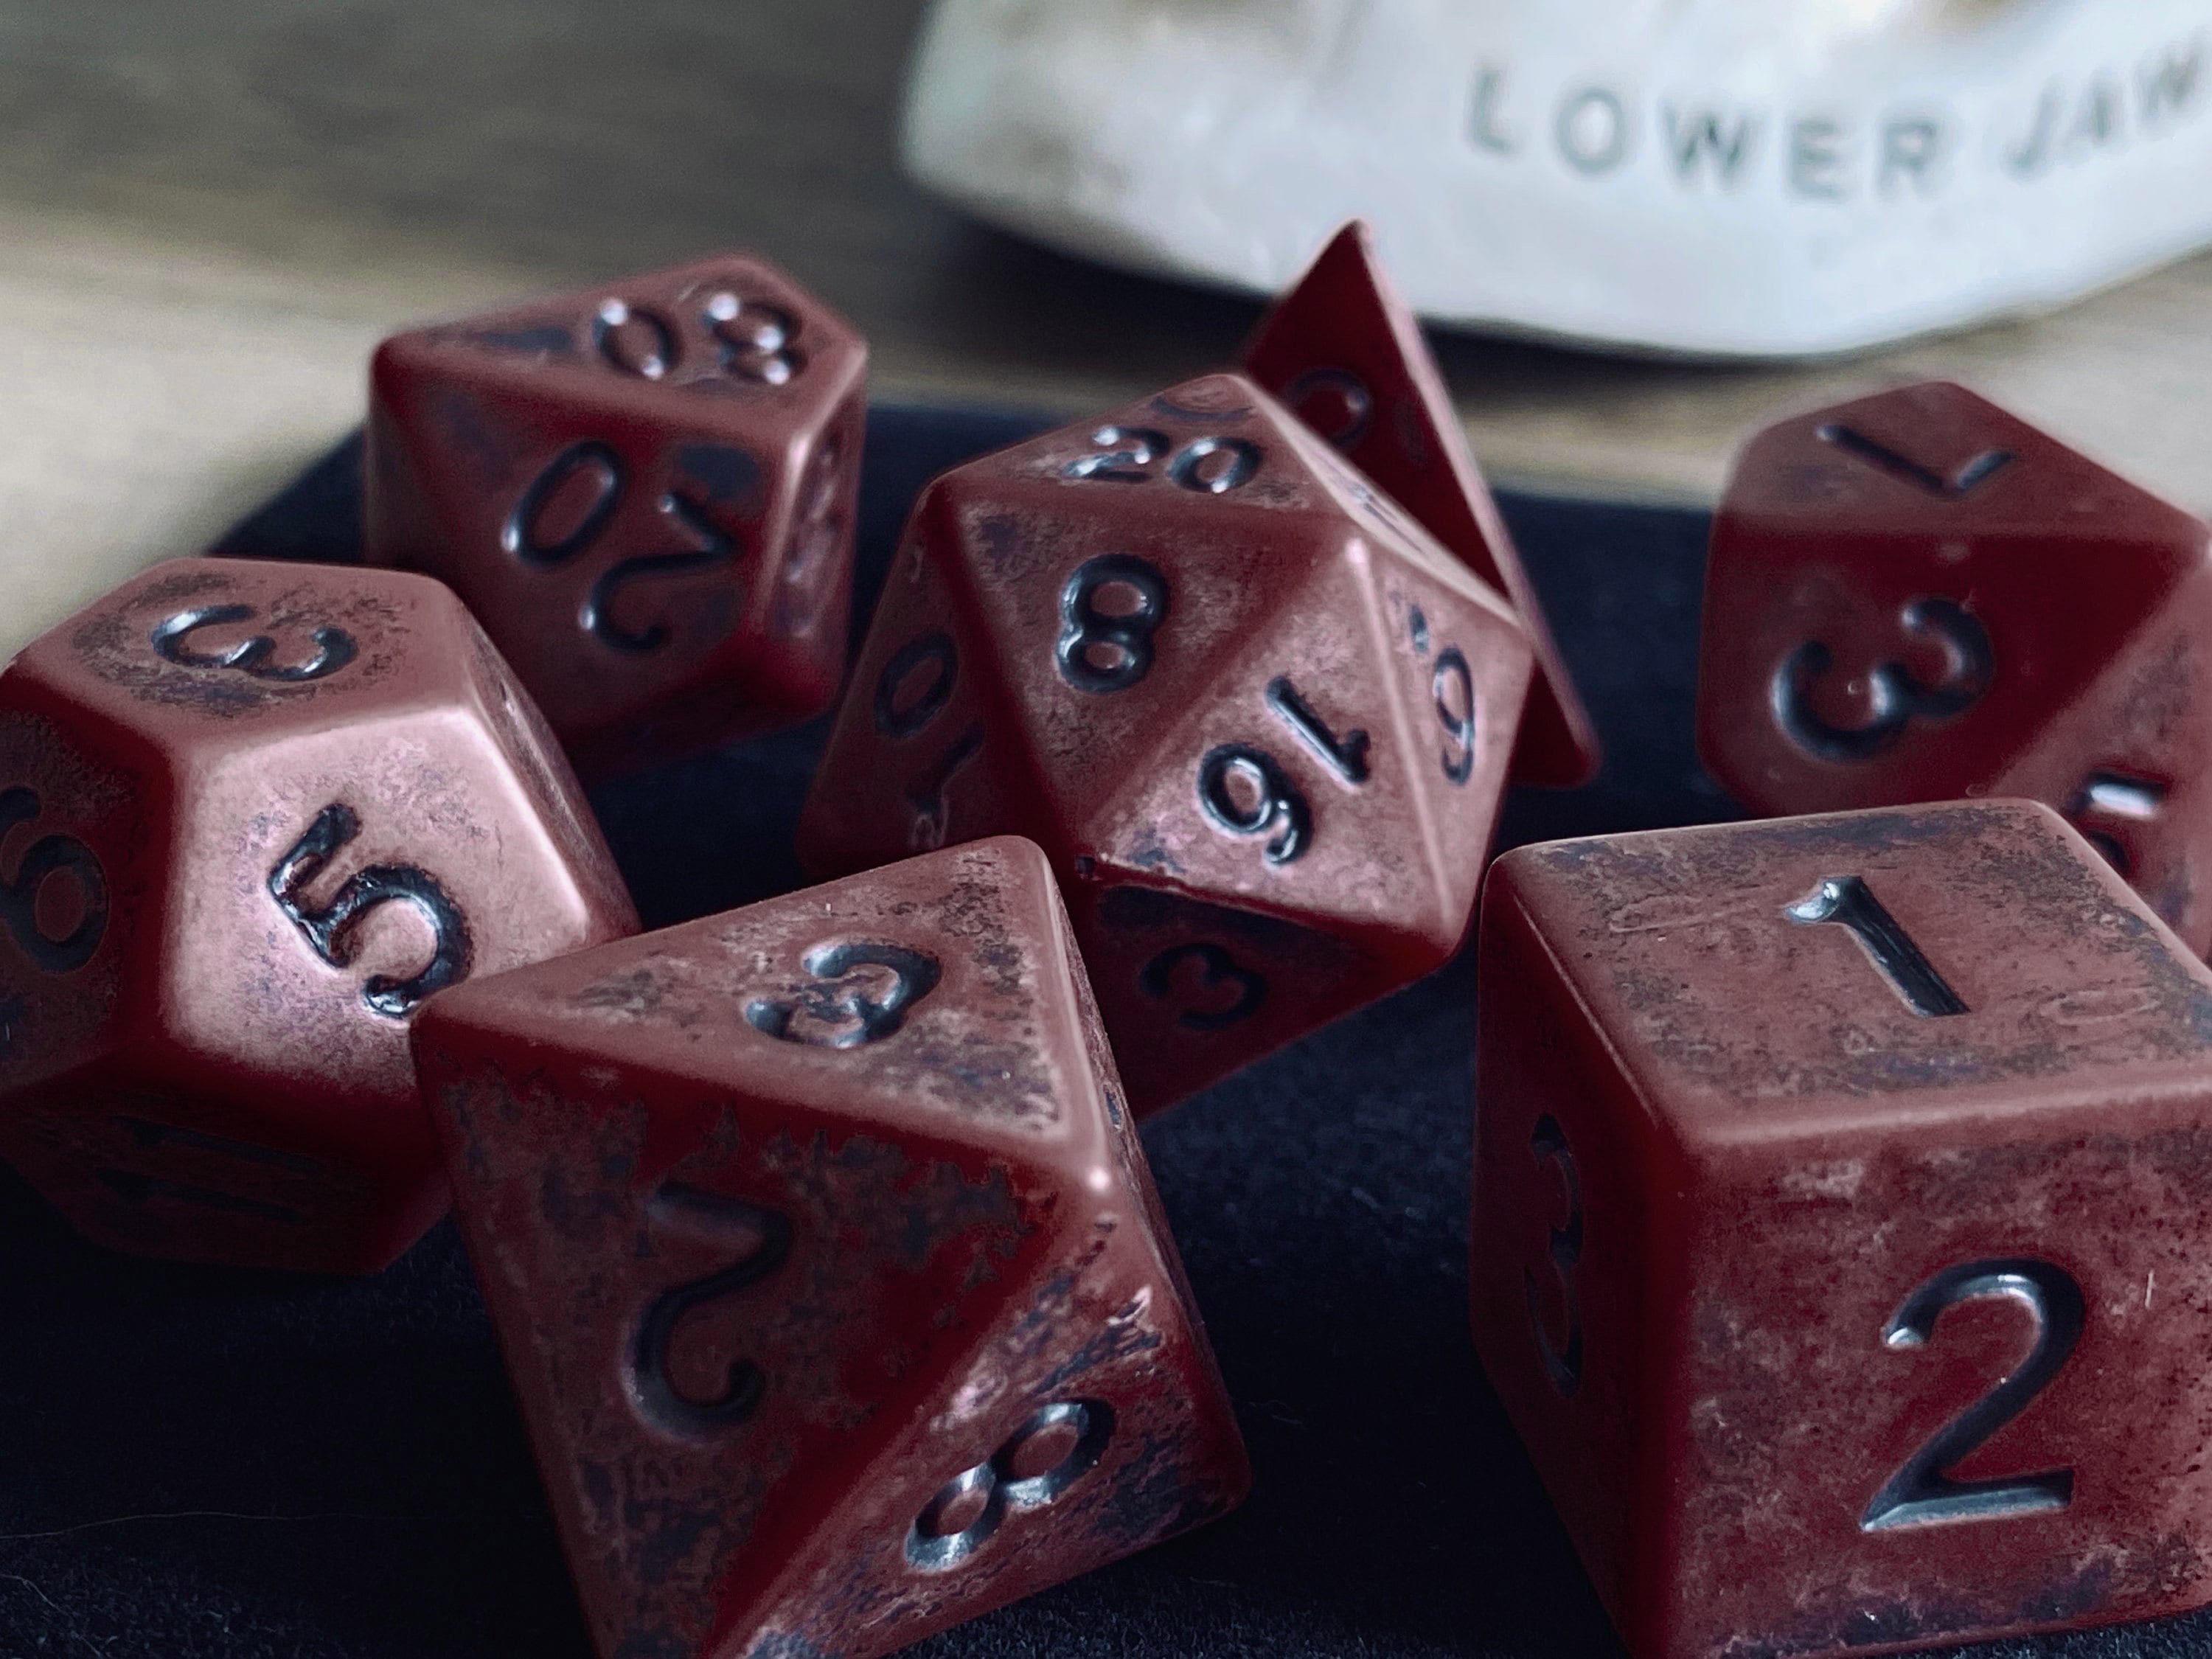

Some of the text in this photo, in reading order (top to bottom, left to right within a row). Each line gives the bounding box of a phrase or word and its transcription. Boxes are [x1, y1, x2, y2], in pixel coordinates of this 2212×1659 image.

[1466, 41, 2208, 201] LOWER JAW
[1064, 425, 1262, 494] 20
[501, 440, 741, 655] 20
[1057, 553, 1171, 692] 8
[151, 605, 359, 683] 3
[1771, 597, 1992, 765] 3
[1197, 676, 1371, 870] 16
[267, 803, 473, 1019] 5
[744, 939, 941, 1049] 3
[1141, 942, 1268, 1031] 3
[1785, 876, 1972, 1016] 1
[621, 1178, 793, 1444] 2
[1525, 1115, 1584, 1396] 3
[1860, 1258, 2085, 1531] 2
[905, 1399, 1116, 1571] 8
